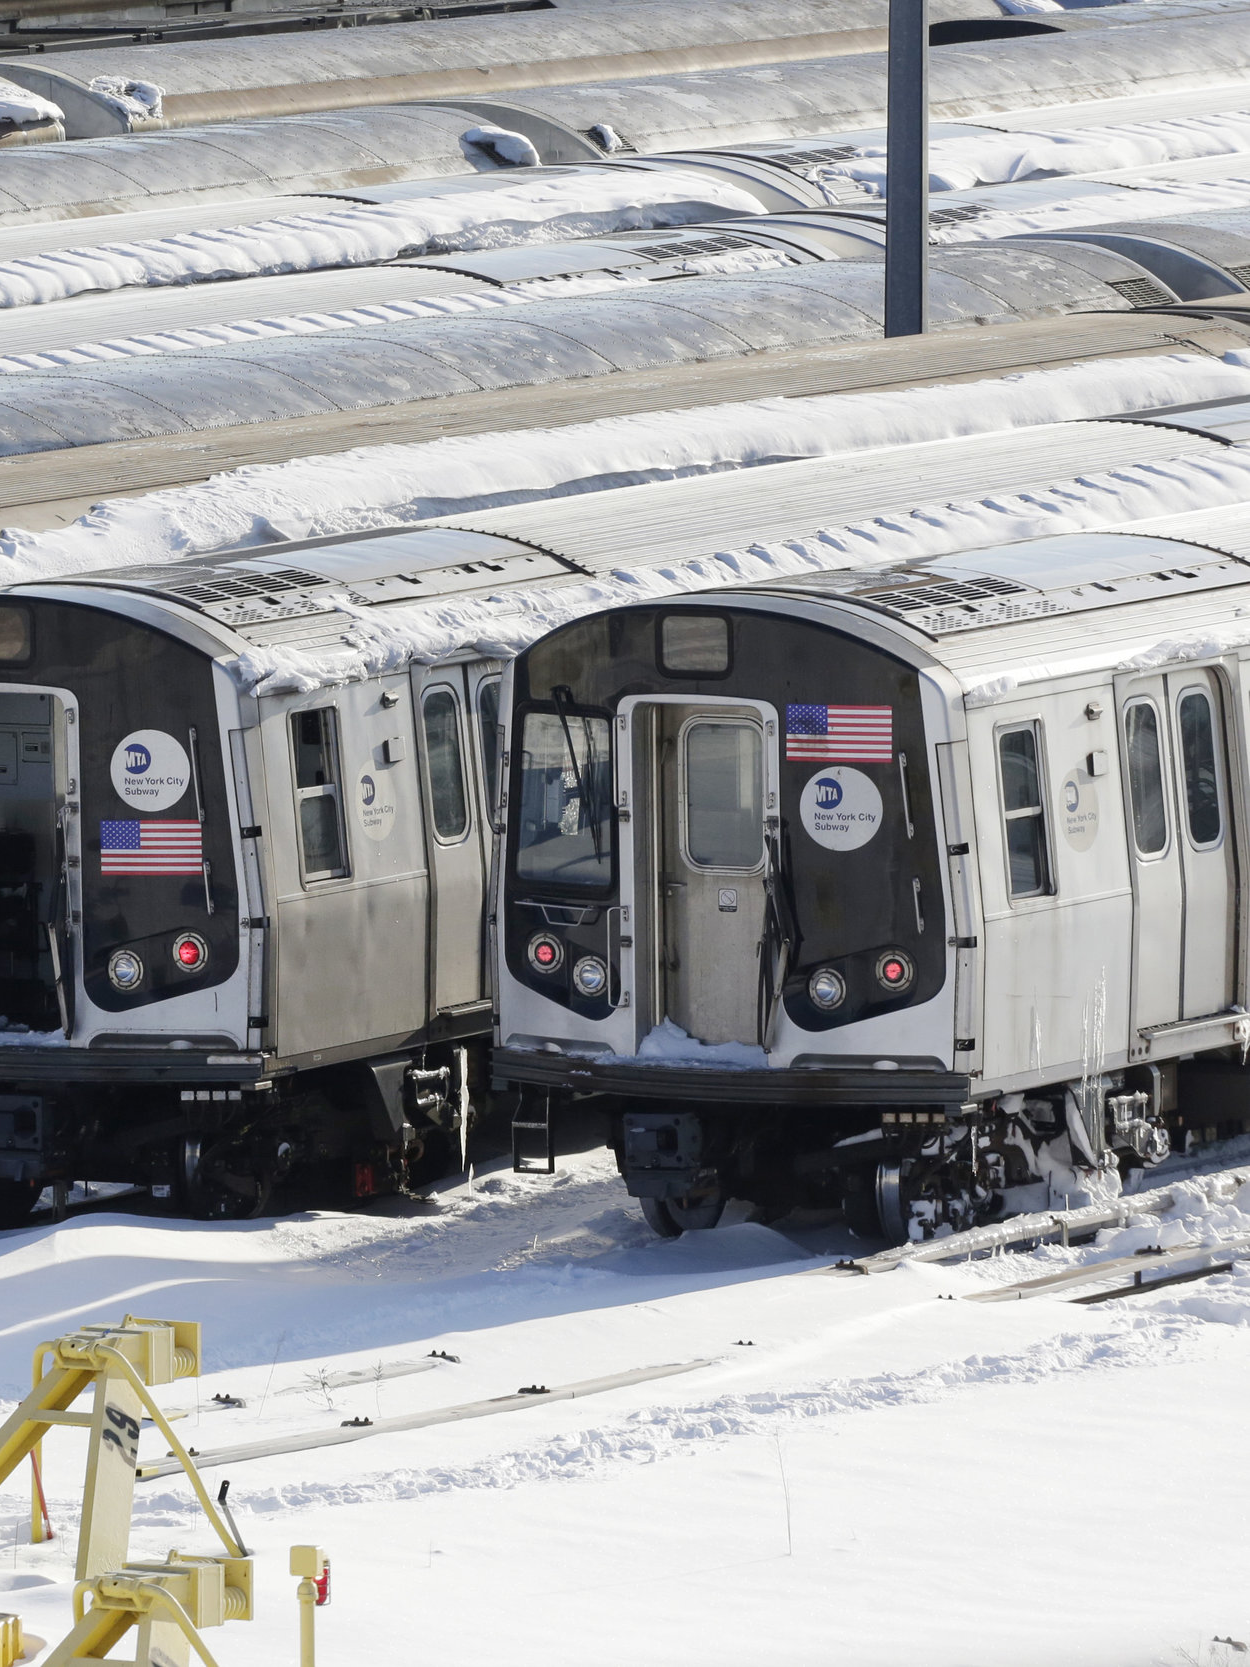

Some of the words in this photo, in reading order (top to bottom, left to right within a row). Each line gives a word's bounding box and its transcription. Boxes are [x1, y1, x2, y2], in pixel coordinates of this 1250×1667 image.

[124, 749, 148, 769] MTA
[124, 777, 144, 786] New
[145, 777, 165, 786] York
[166, 776, 185, 787] City
[125, 787, 160, 797] Subway
[814, 783, 839, 803] MTA
[814, 812, 834, 821] New
[836, 812, 856, 821] York
[858, 812, 877, 823] City
[815, 822, 850, 833] Subway
[102, 1404, 140, 1469] 29
